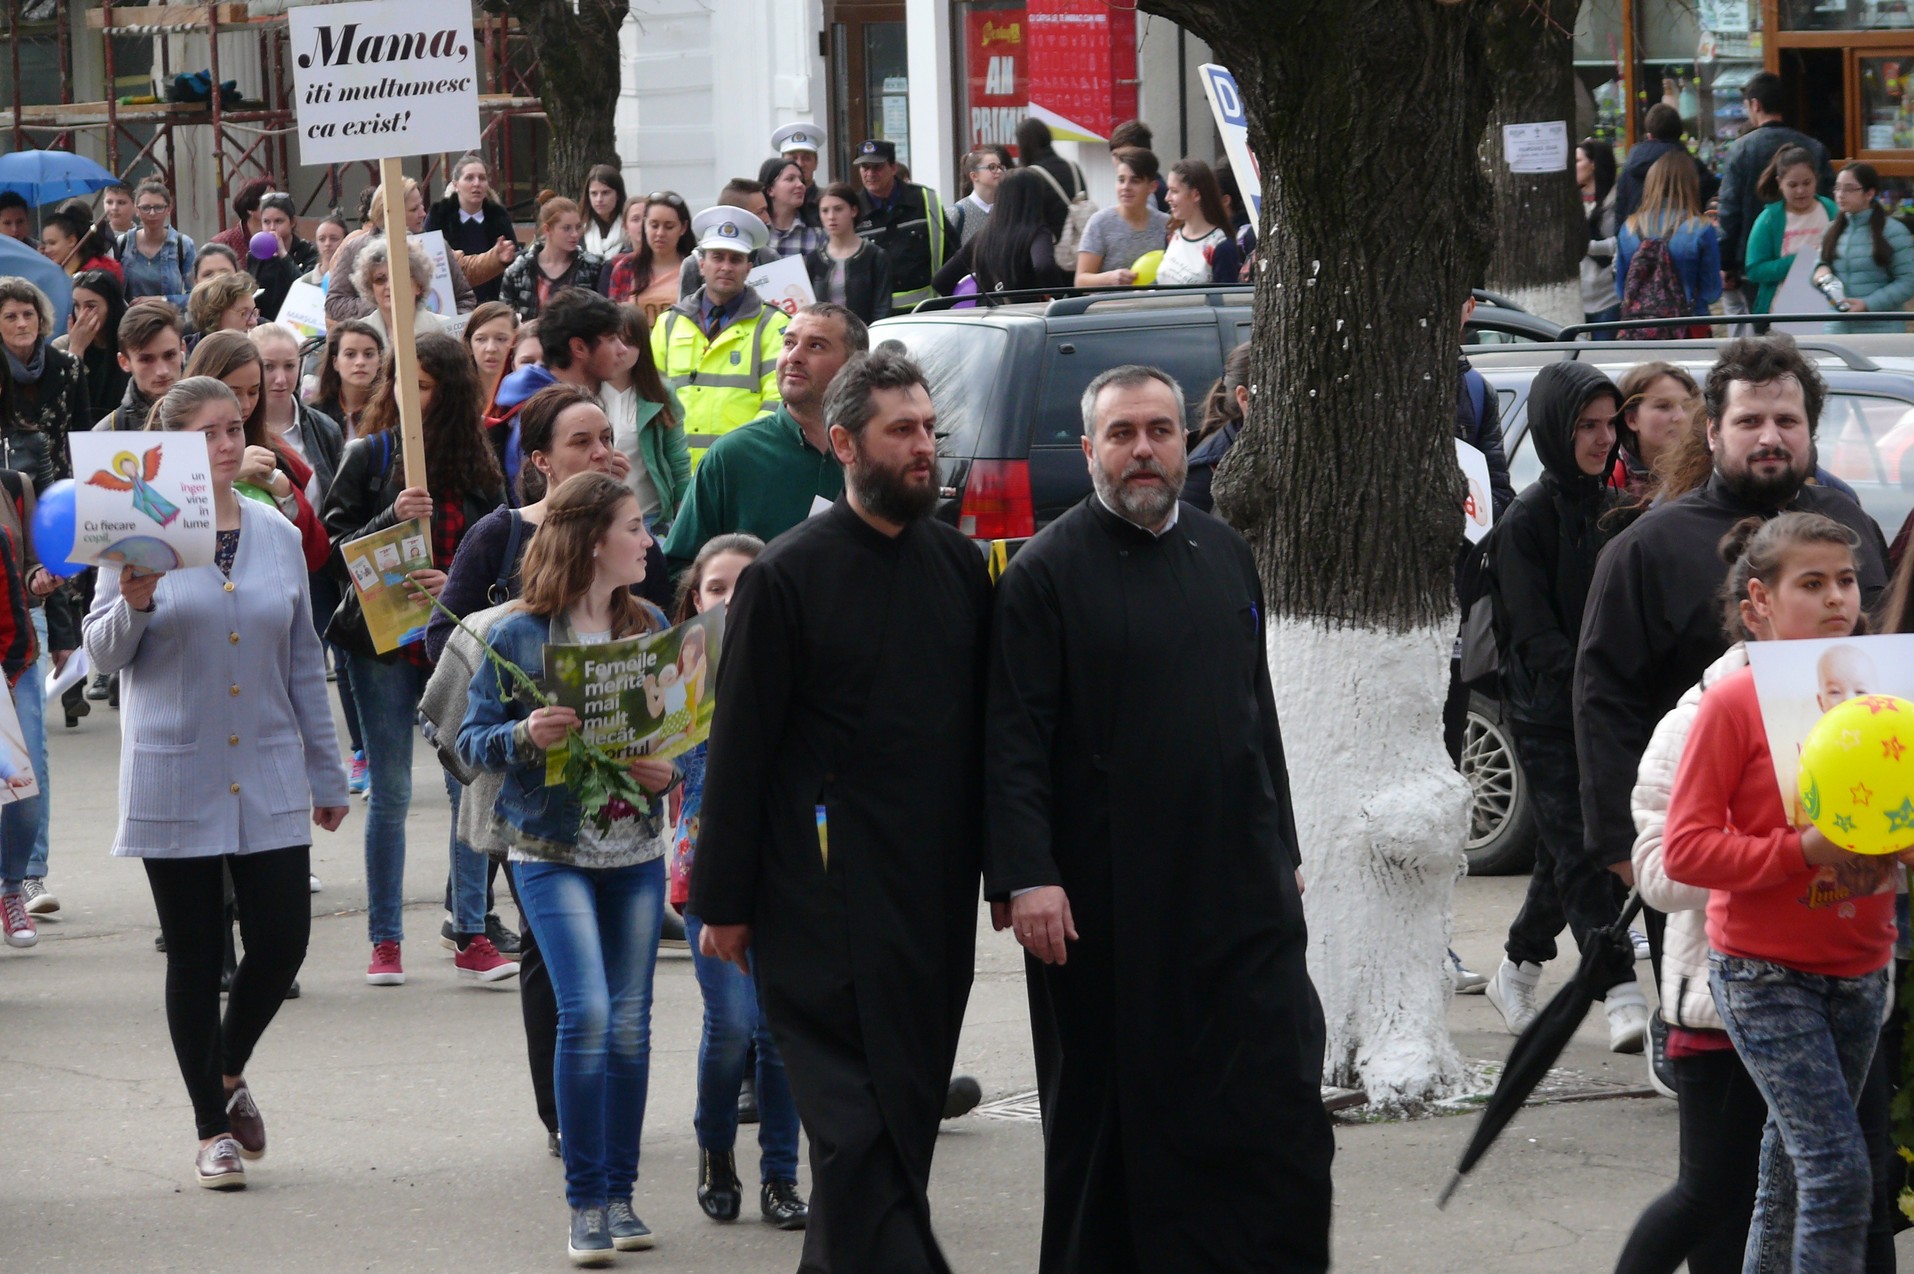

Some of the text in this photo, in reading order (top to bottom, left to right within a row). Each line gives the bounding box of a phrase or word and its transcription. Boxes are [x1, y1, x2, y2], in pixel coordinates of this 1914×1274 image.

[298, 23, 469, 69] Mama,
[985, 56, 1014, 94] AM
[305, 77, 471, 104] iti multumesc
[308, 110, 411, 139] ca exist!
[192, 473, 205, 481] un
[186, 496, 208, 504] vine
[84, 520, 136, 531] Cu fiecare
[183, 518, 210, 529] lume
[584, 652, 657, 679] Femeile
[585, 693, 620, 714] mai
[584, 711, 629, 731] mult
